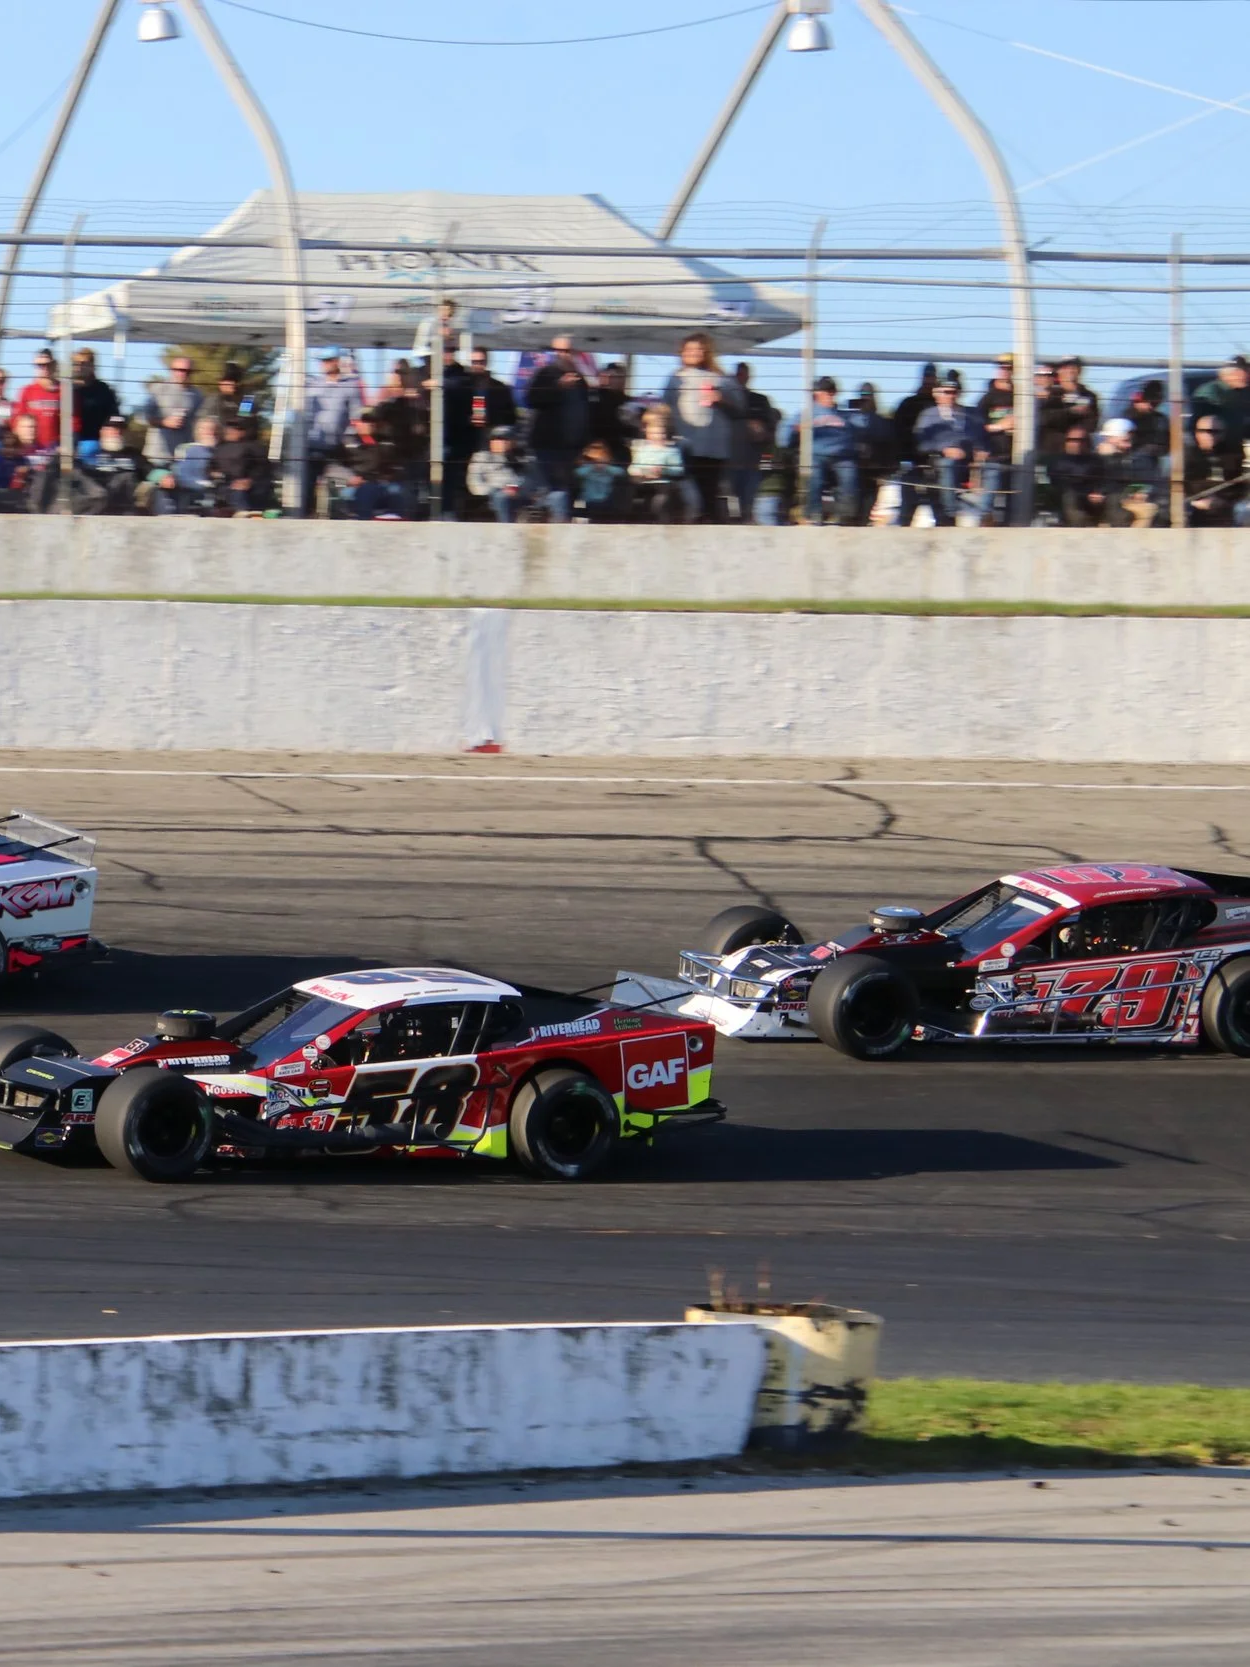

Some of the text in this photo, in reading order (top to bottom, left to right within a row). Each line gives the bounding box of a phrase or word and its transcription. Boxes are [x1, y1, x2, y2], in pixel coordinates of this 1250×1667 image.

[1054, 959, 1184, 1031] 79
[539, 1018, 601, 1038] RIVERHEAD
[125, 1039, 149, 1053] 58
[166, 1055, 230, 1066] RIVERHEAD
[627, 1058, 685, 1090] GAF
[336, 1062, 480, 1141] 58
